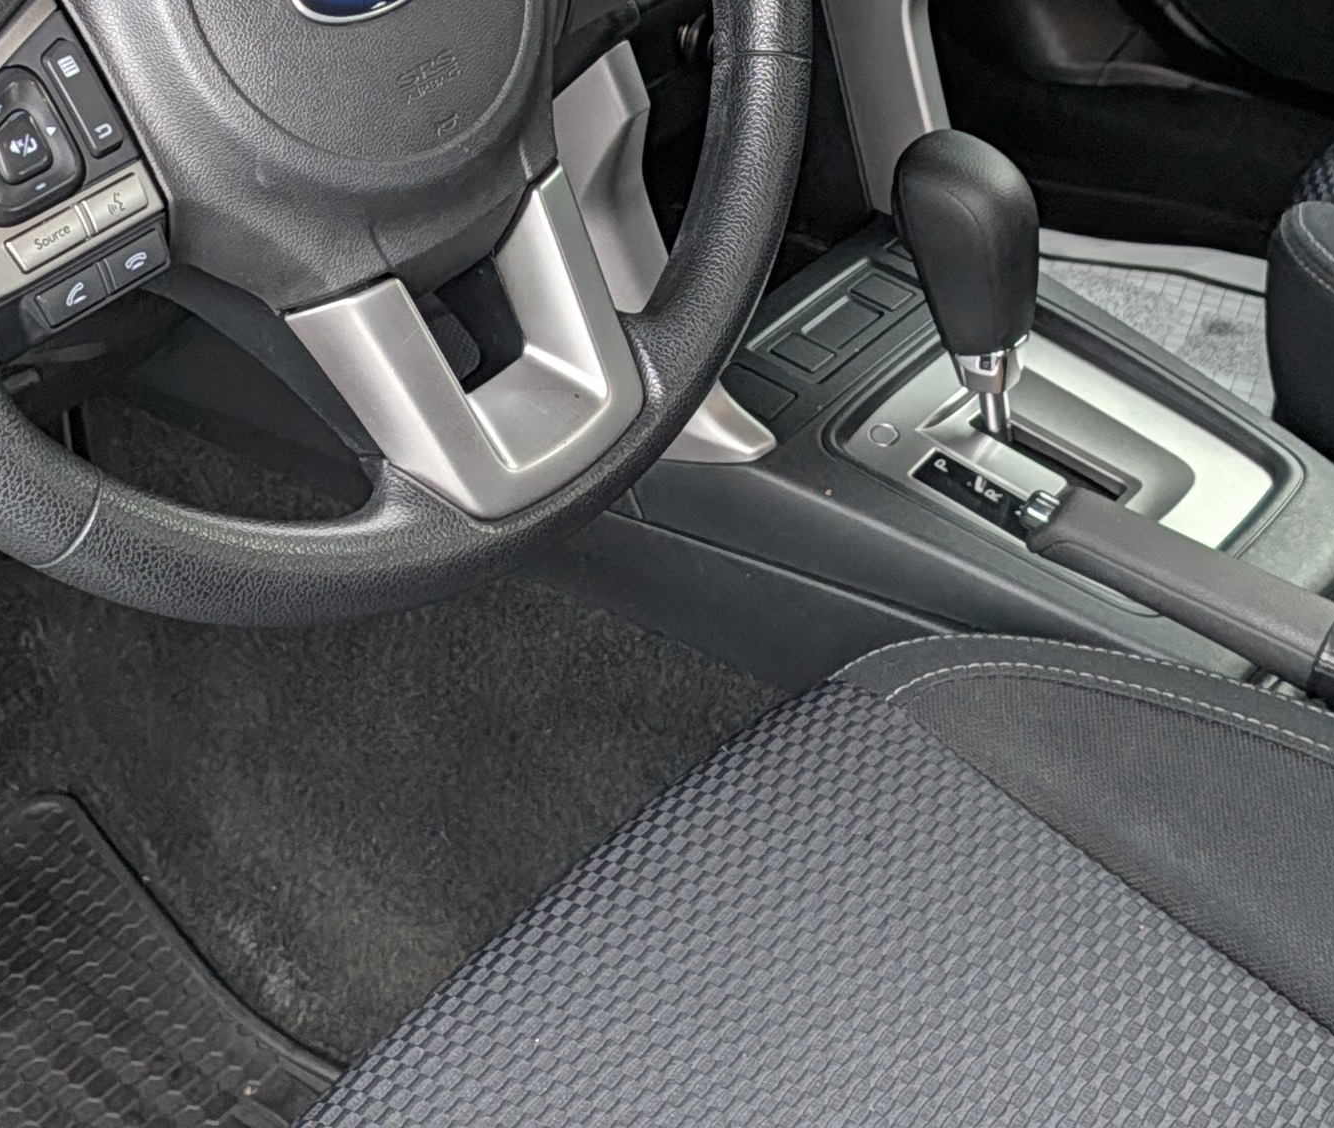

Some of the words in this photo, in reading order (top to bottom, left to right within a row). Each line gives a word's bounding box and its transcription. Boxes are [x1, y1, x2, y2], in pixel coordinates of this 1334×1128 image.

[34, 225, 71, 251] Source
[933, 458, 948, 472] P
[983, 488, 1003, 503] R
